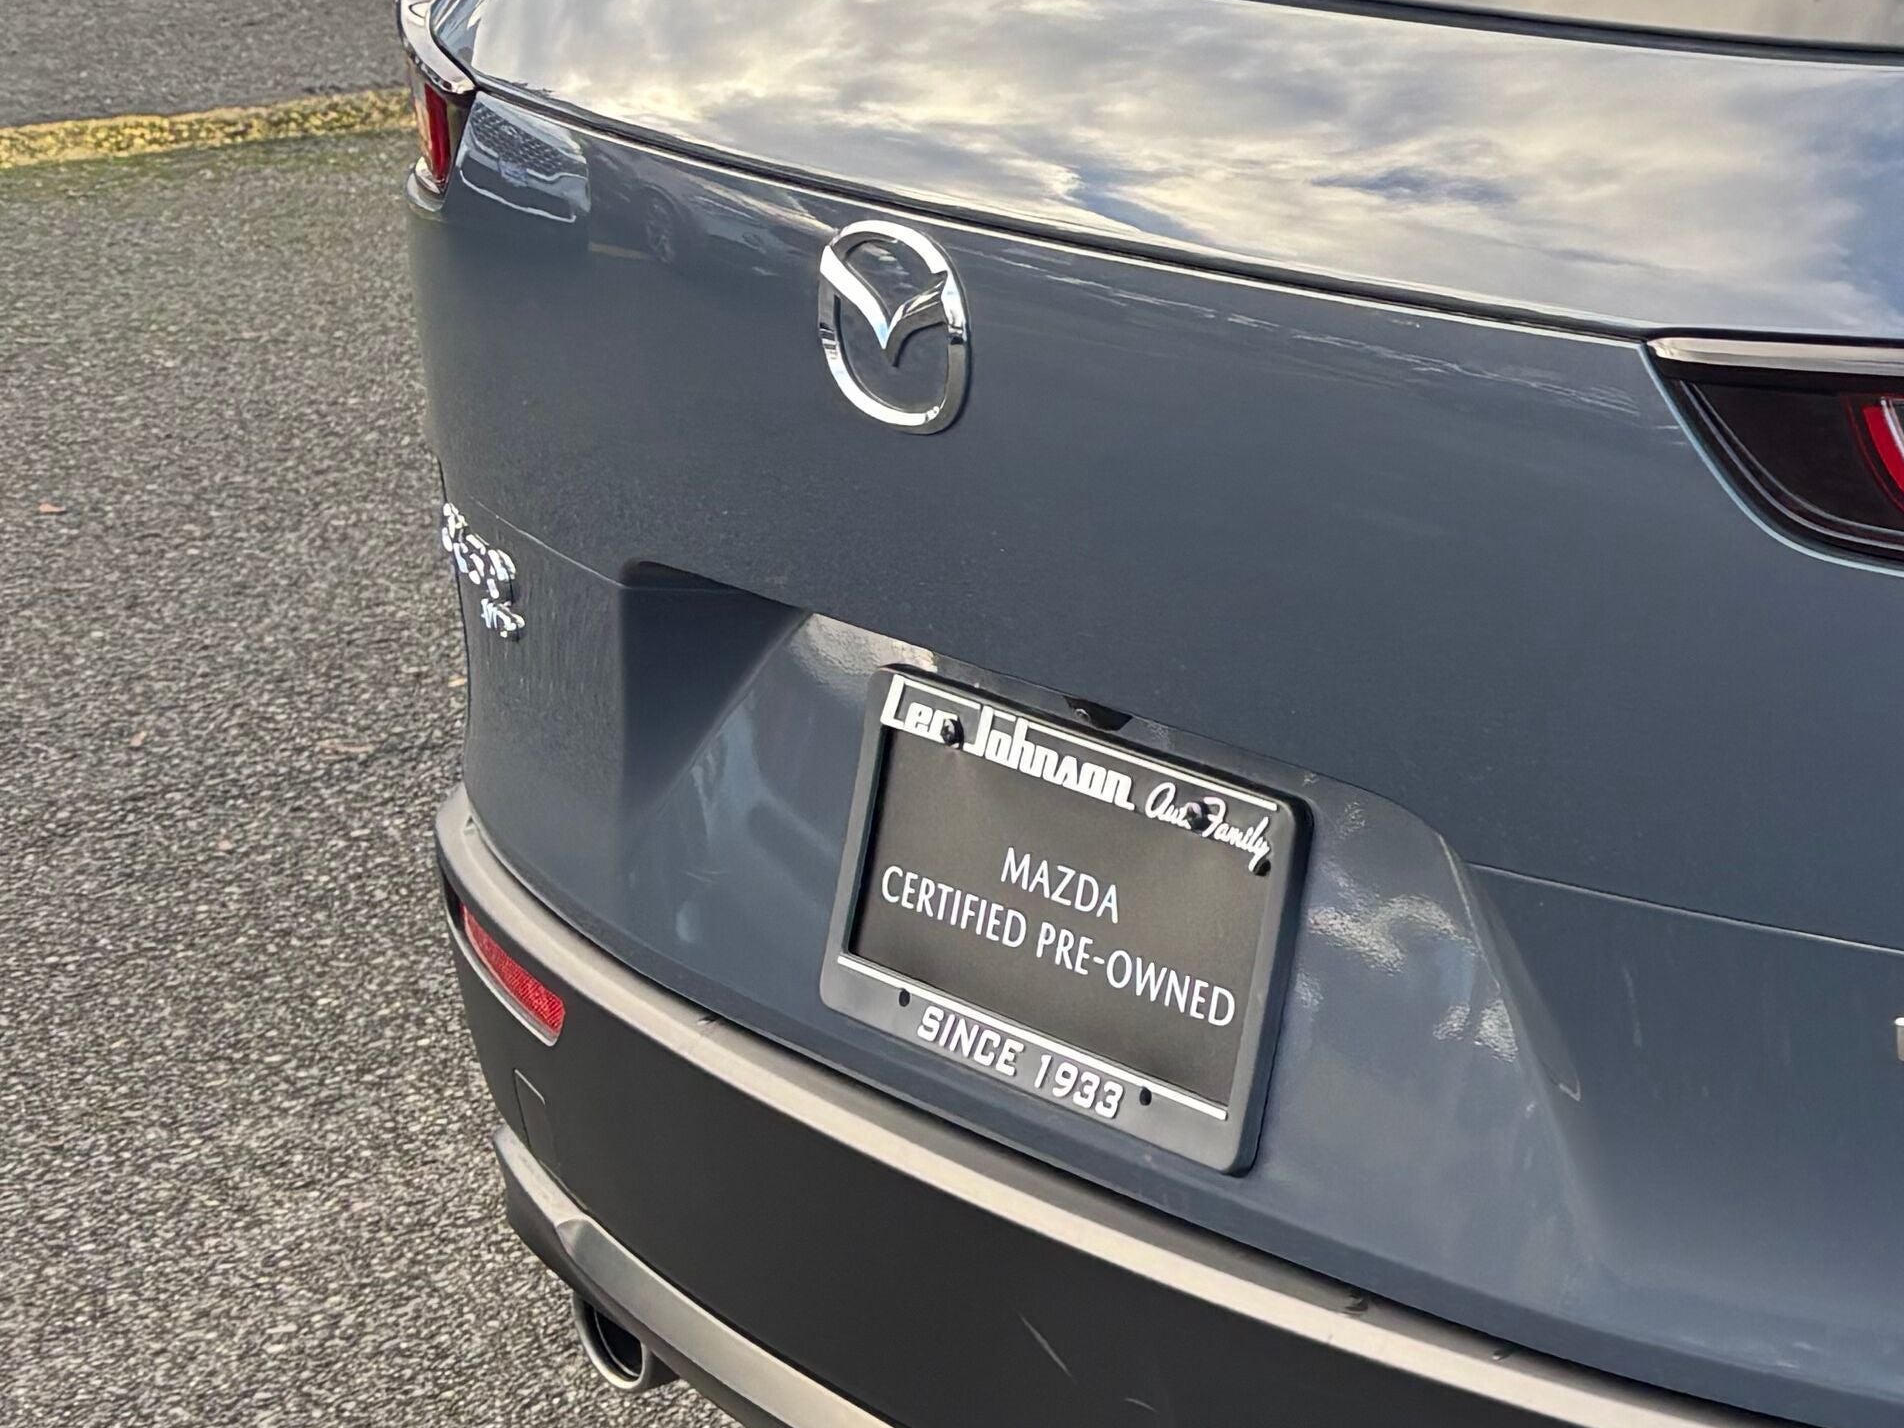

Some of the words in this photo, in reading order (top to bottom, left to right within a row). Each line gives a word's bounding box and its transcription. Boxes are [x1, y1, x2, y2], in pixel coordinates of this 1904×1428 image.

[962, 704, 1136, 811] Johnson
[1145, 781, 1206, 831] Aut
[1202, 796, 1272, 874] Family
[881, 865, 1027, 948] CERTIFIED
[1036, 922, 1236, 1028] PRE-OWNED
[1001, 846, 1119, 924] MAZDA
[916, 1006, 1025, 1077] SINCE
[1034, 1054, 1124, 1120] 1933
